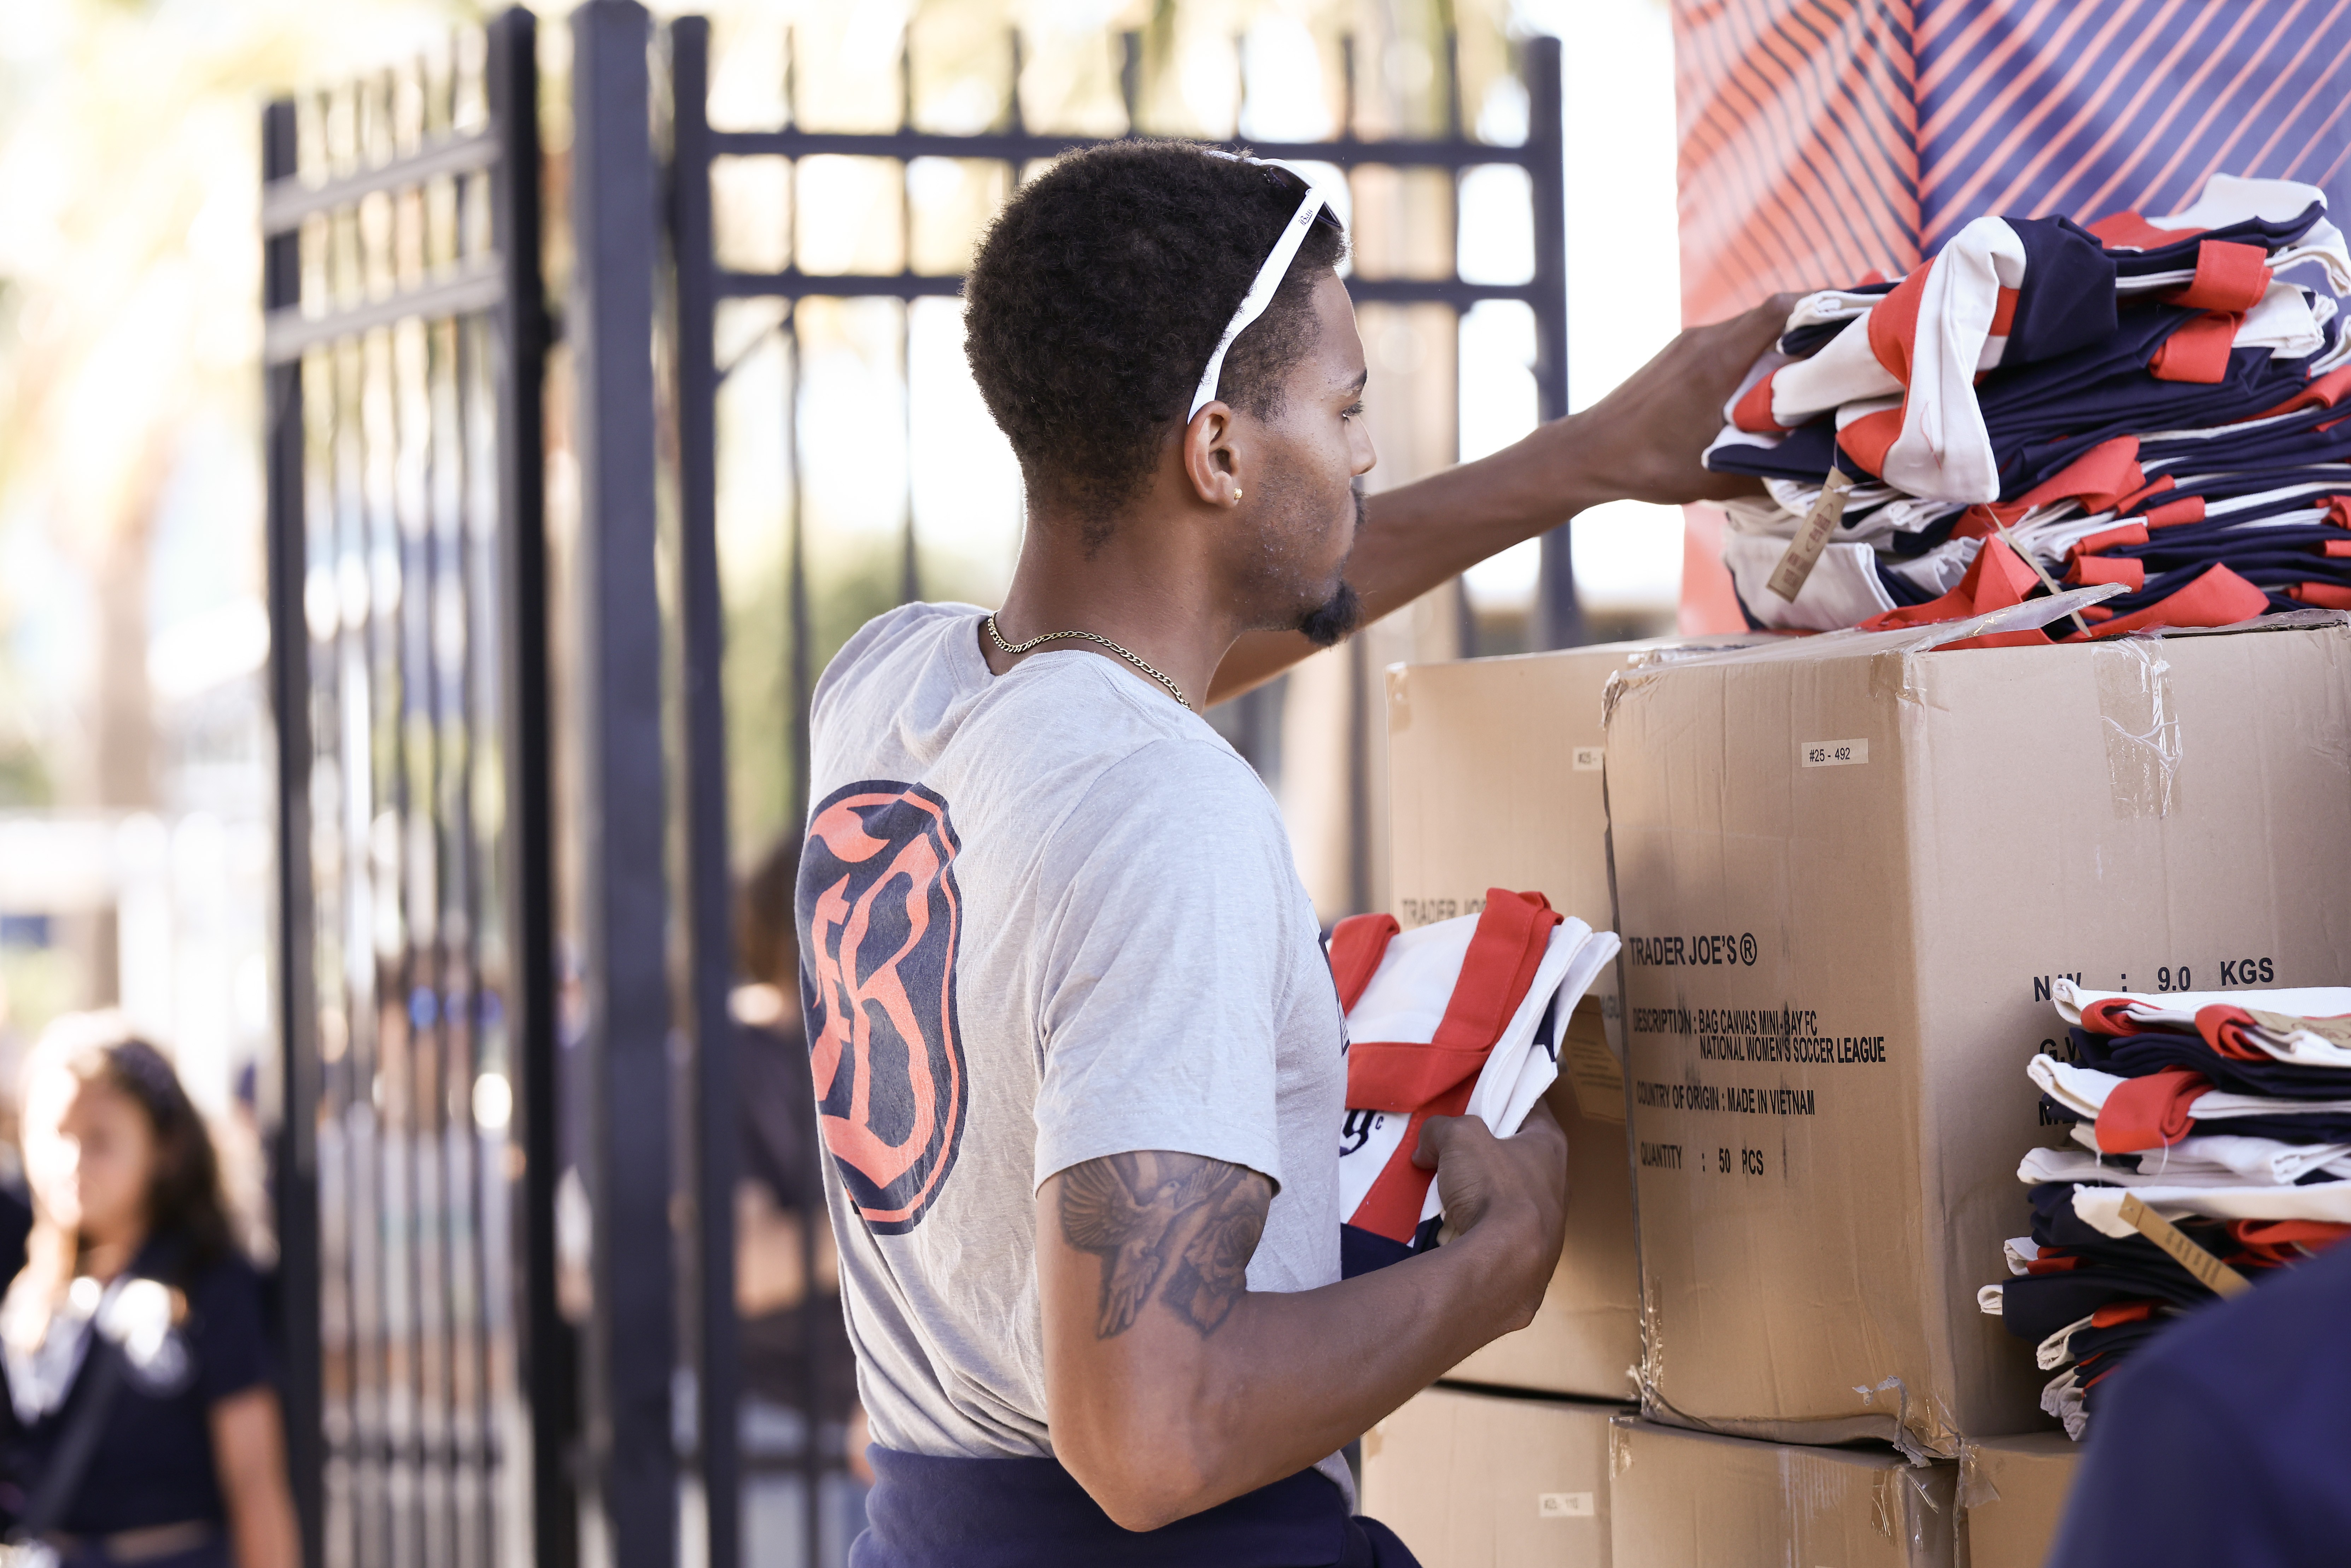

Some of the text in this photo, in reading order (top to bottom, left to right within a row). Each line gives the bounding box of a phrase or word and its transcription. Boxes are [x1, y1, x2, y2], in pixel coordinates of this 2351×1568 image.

[1809, 748, 1825, 762] #25
[1835, 747, 1850, 760] 492
[1629, 936, 1685, 965] TRADER
[1689, 935, 1737, 965] JOE'S
[2157, 966, 2191, 991] 9.0
[2220, 957, 2274, 986] KGS
[1633, 1008, 1691, 1034] DESCRIPTION
[1698, 1009, 1718, 1034] BAG
[1720, 1009, 1757, 1035] CANVAS
[1805, 1010, 1817, 1036] FC
[1700, 1035, 1886, 1063] NATIONAL WOMEN'S SOCCER LEAGUE
[1637, 1080, 1670, 1108] COUNTRY
[1672, 1084, 1684, 1109] OF
[1686, 1084, 1720, 1111] ORIGIN
[1727, 1087, 1755, 1113] MADE
[1758, 1089, 1767, 1114] IN
[1769, 1089, 1815, 1115] VIETNAM
[1641, 1141, 1682, 1170] QUANTITY
[1719, 1148, 1731, 1173] 50
[1742, 1148, 1764, 1175] PCS
